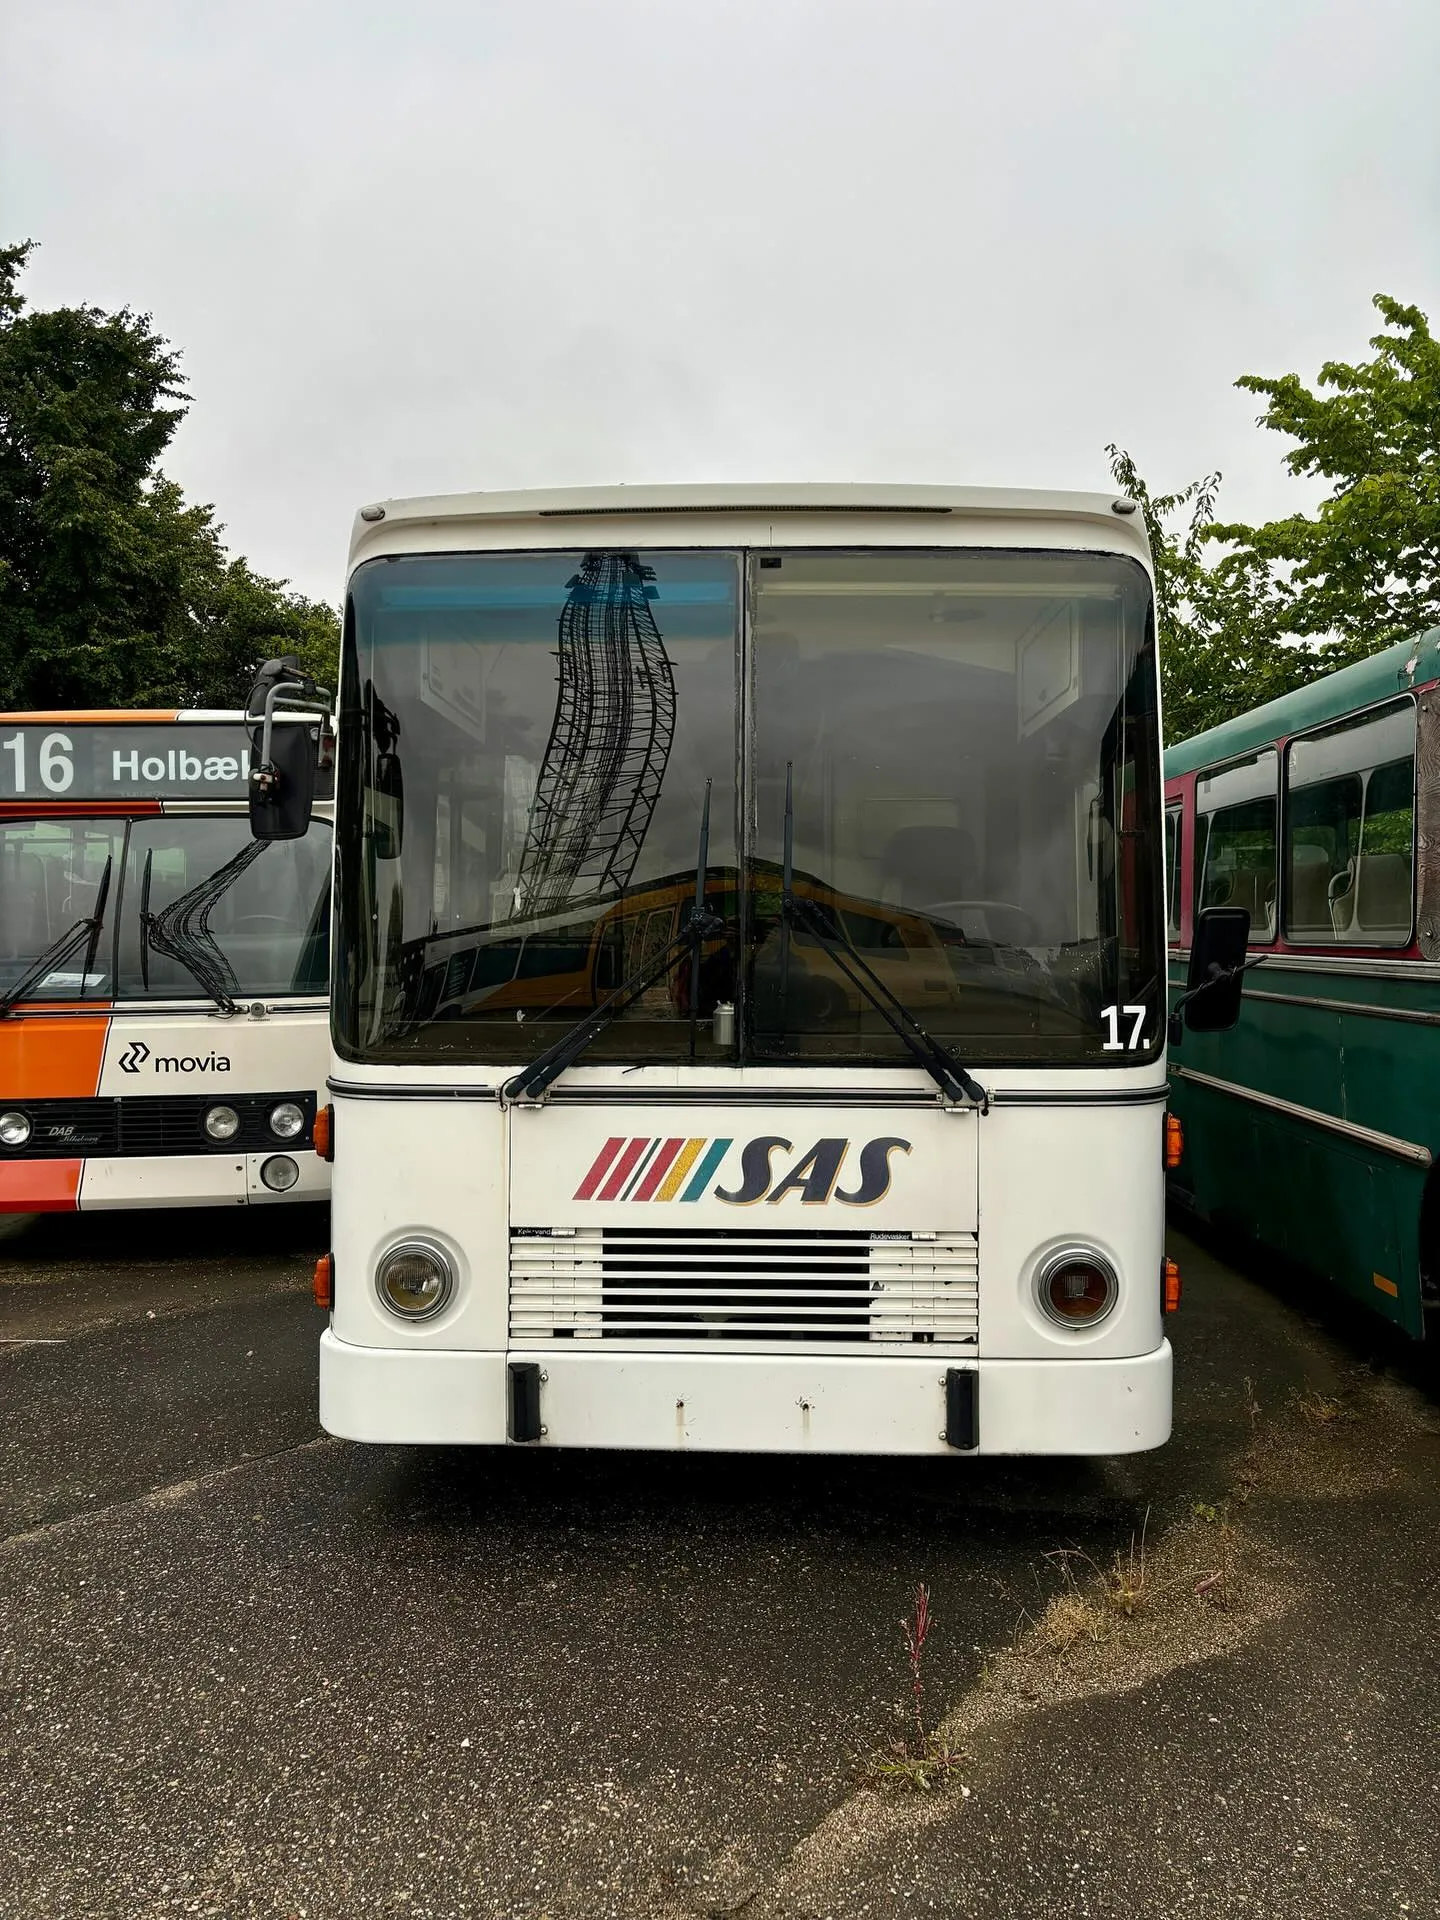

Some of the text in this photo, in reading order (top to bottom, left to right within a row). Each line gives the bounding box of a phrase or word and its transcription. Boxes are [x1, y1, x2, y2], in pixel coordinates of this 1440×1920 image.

[3, 732, 74, 793] 16
[1100, 1005, 1150, 1050] 17.
[155, 1051, 231, 1072] movia
[48, 1126, 75, 1136] DAB
[713, 1135, 914, 1207] SAS
